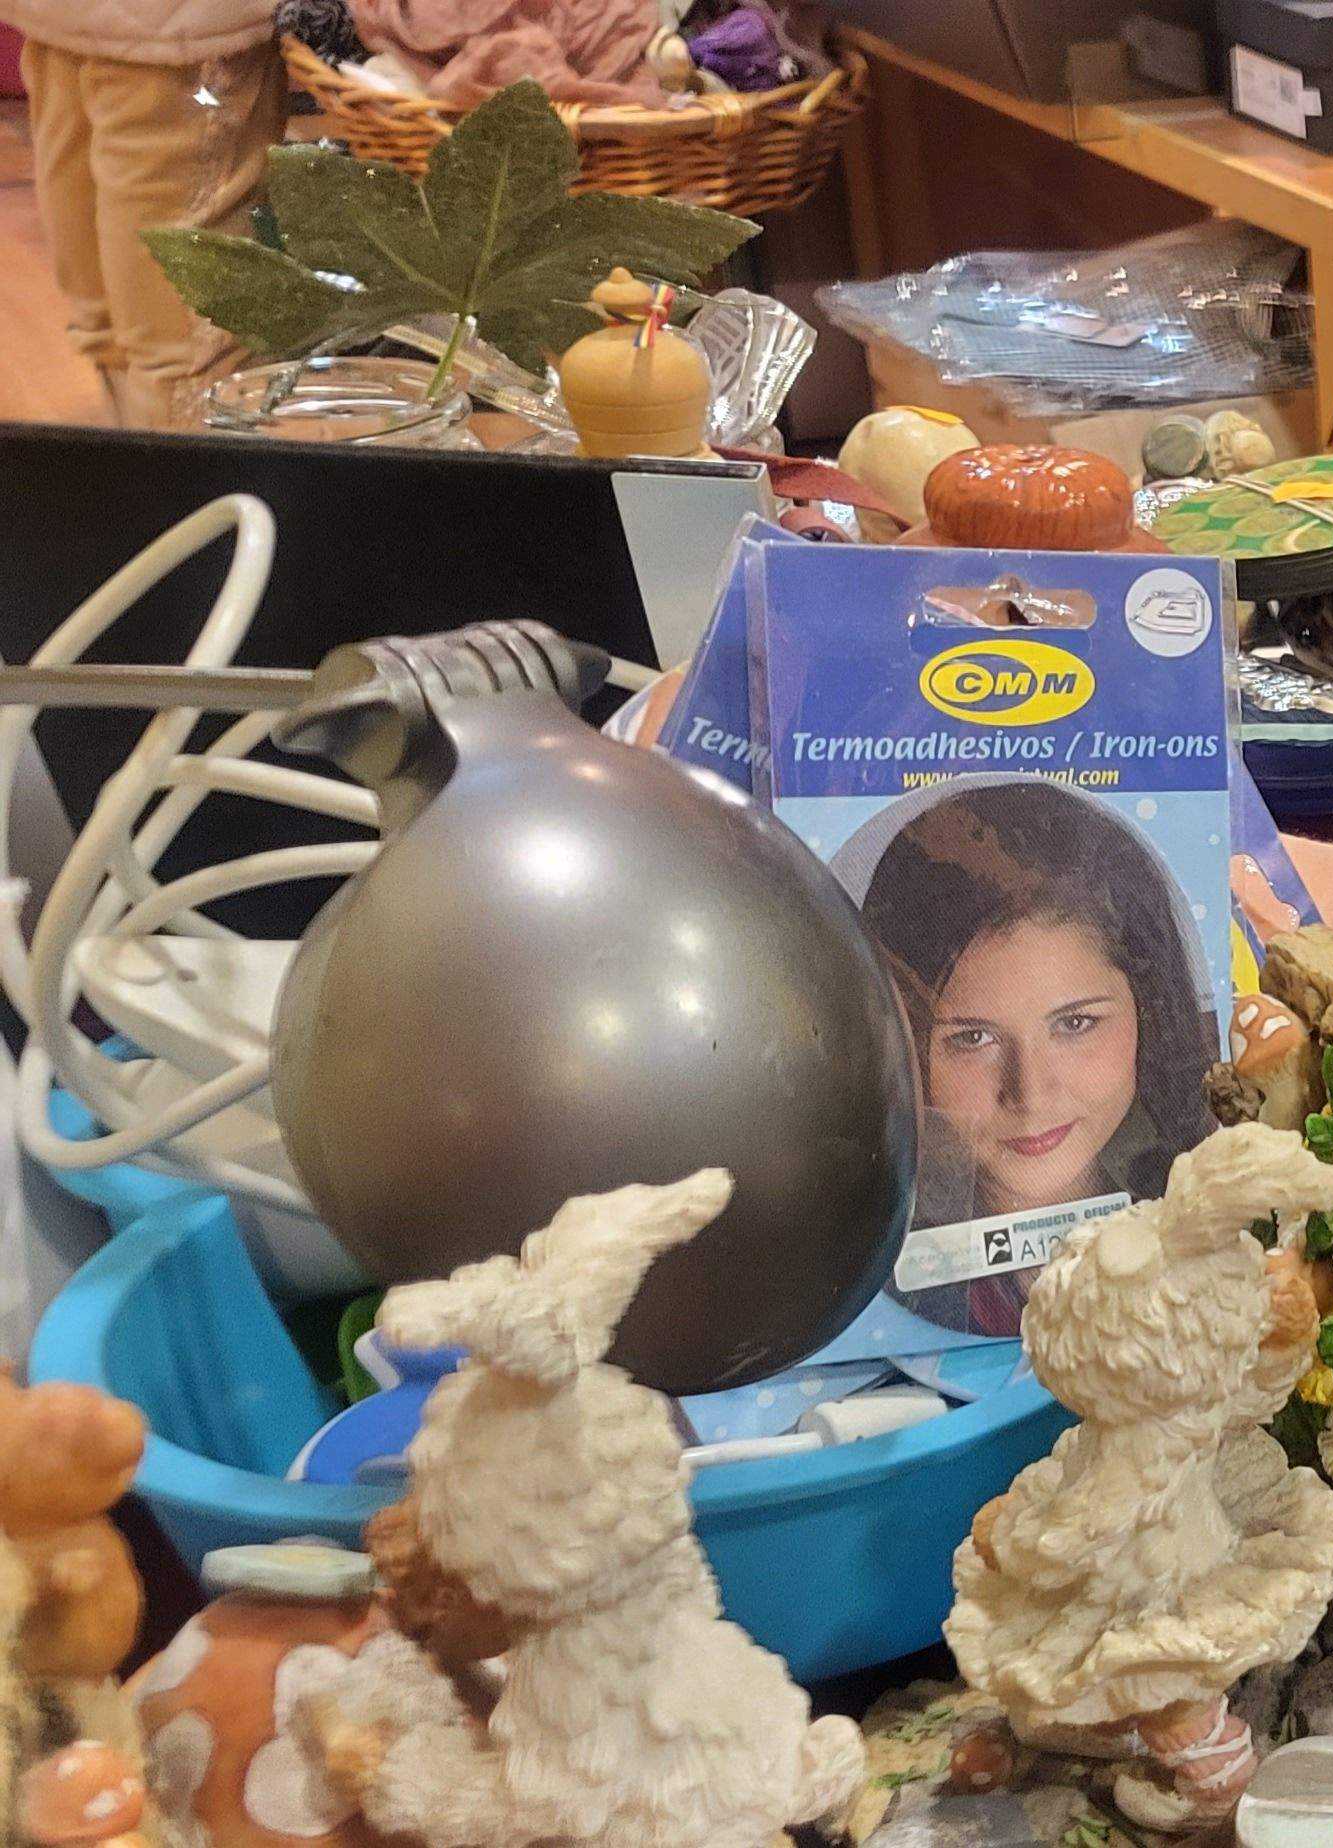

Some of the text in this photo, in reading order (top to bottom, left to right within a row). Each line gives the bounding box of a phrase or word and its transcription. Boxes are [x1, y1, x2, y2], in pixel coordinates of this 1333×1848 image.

[955, 672, 1077, 695] CMM
[793, 731, 1055, 762] Termoadhesivos
[1089, 731, 1219, 758] Iron-ons
[1012, 1212, 1076, 1232] PRODUCTO
